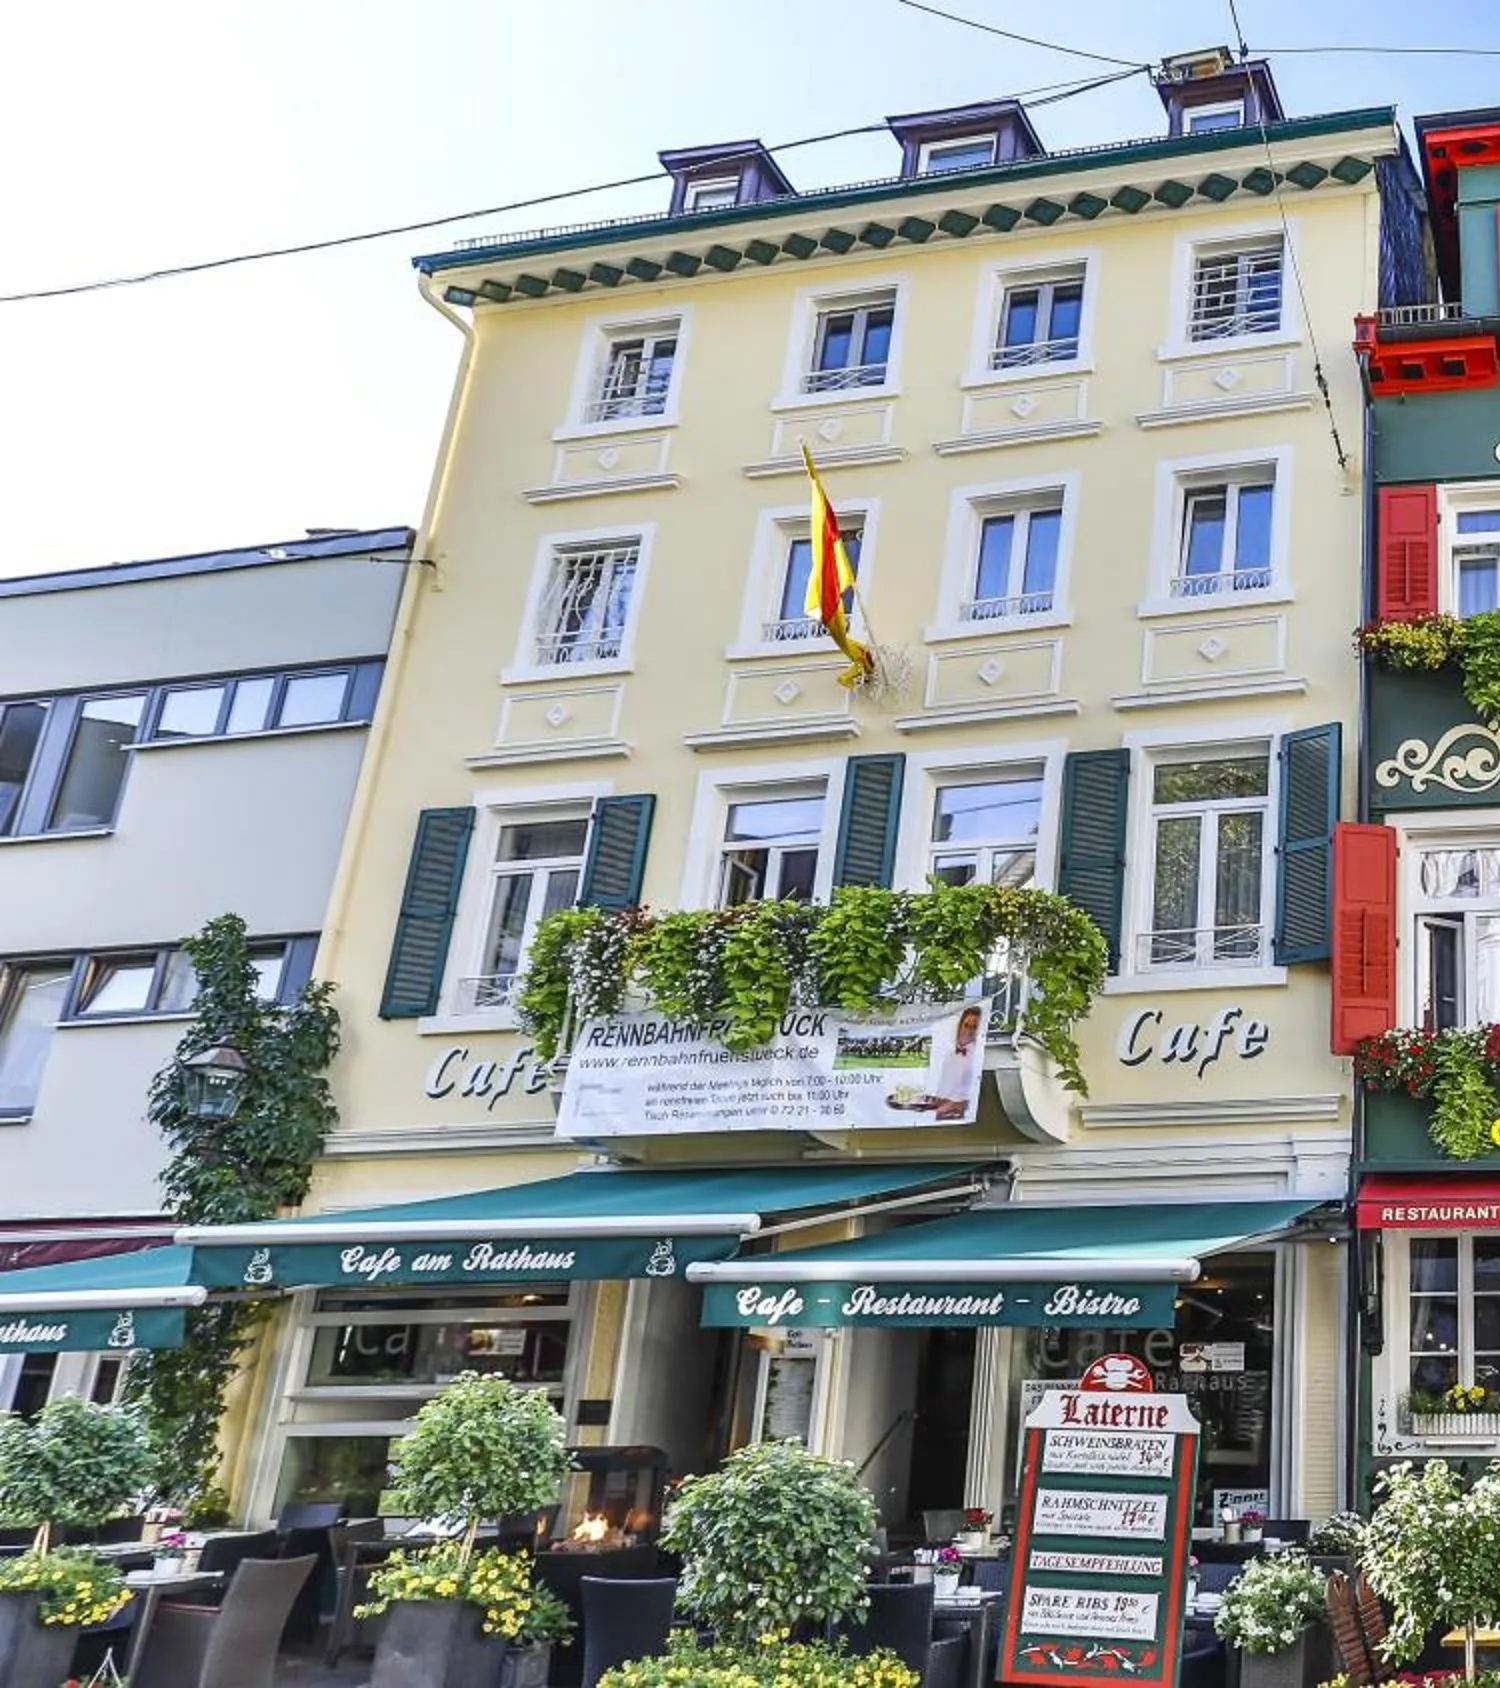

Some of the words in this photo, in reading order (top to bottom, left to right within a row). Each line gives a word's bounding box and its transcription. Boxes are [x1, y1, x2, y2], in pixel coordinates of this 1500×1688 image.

[1115, 1006, 1270, 1079] Cafe
[1382, 1205, 1500, 1221] RESTAURANT
[340, 1245, 401, 1281] Cafe
[411, 1252, 452, 1271] am
[462, 1242, 576, 1271] Rathaus
[736, 1286, 804, 1325] Cafe
[842, 1284, 1005, 1316] Restaurant
[1043, 1284, 1140, 1316] Bistro
[1060, 1394, 1169, 1429] Laterne
[1049, 1436, 1168, 1451] SCHWEINSBRATEN
[1033, 1555, 1161, 1573] TAGESEMPFEHLUNG
